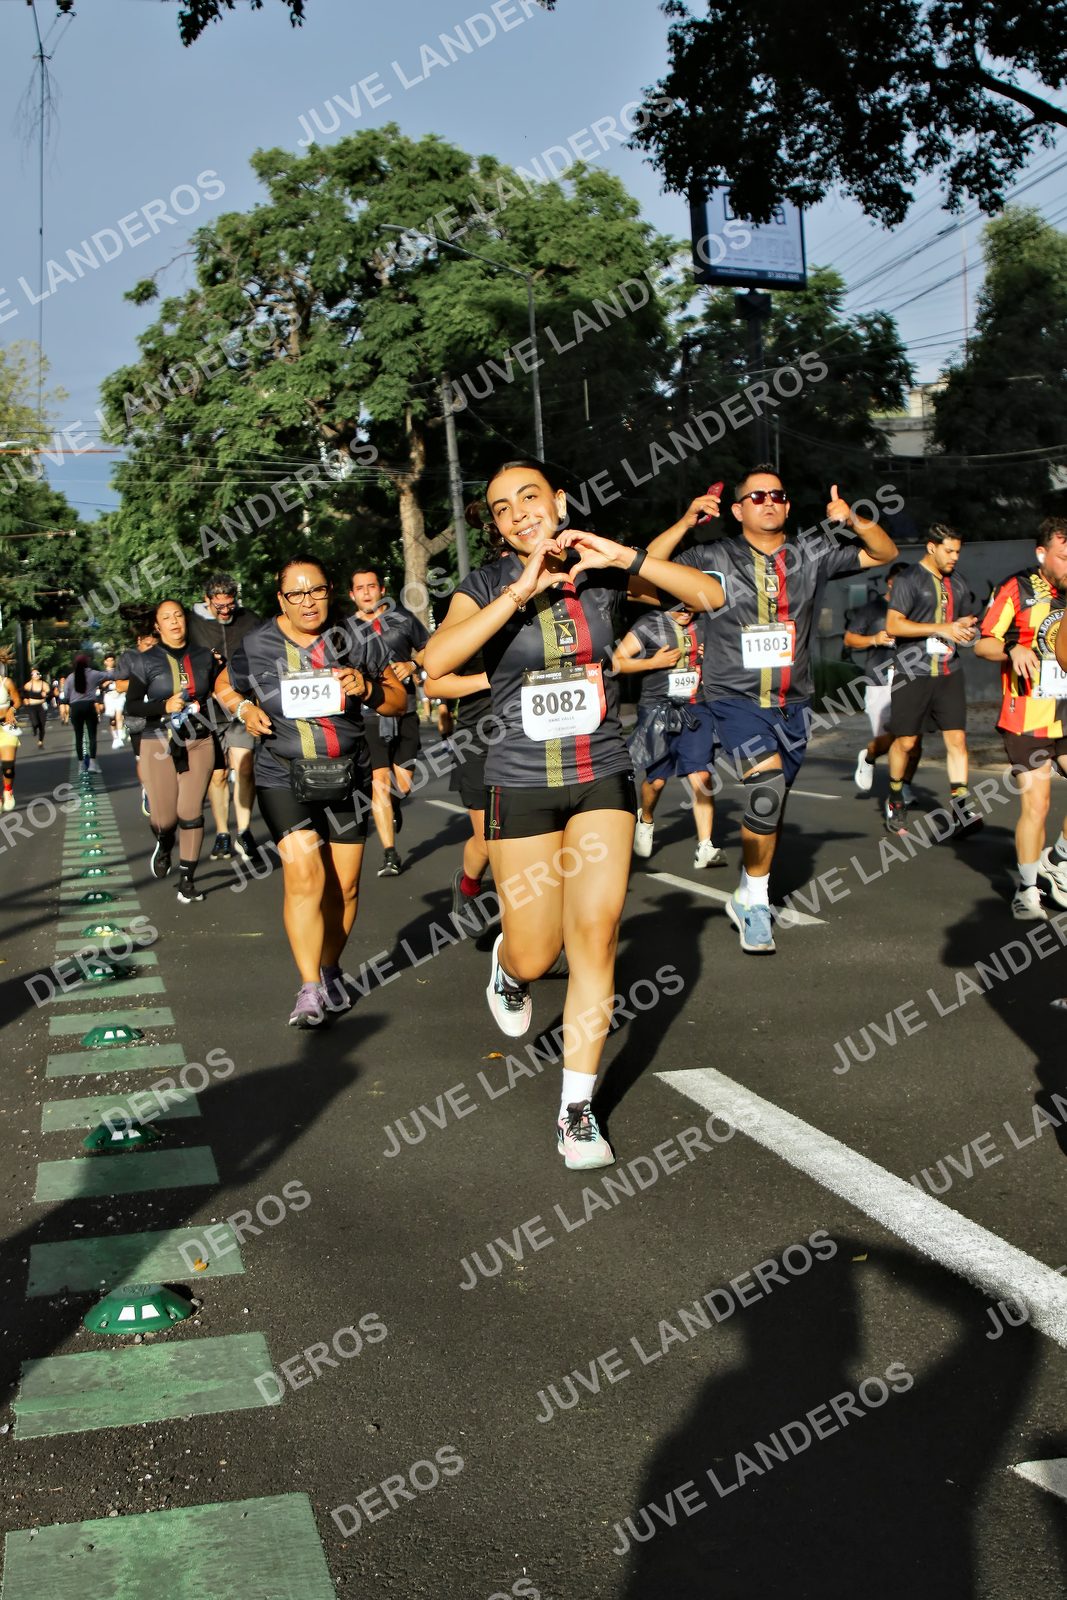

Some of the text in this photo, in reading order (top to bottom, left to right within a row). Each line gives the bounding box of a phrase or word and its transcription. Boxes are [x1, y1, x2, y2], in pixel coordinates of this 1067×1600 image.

[745, 636, 788, 653] 11803
[674, 675, 696, 687] 9494
[290, 684, 331, 700] 9954
[531, 688, 587, 716] 8082
